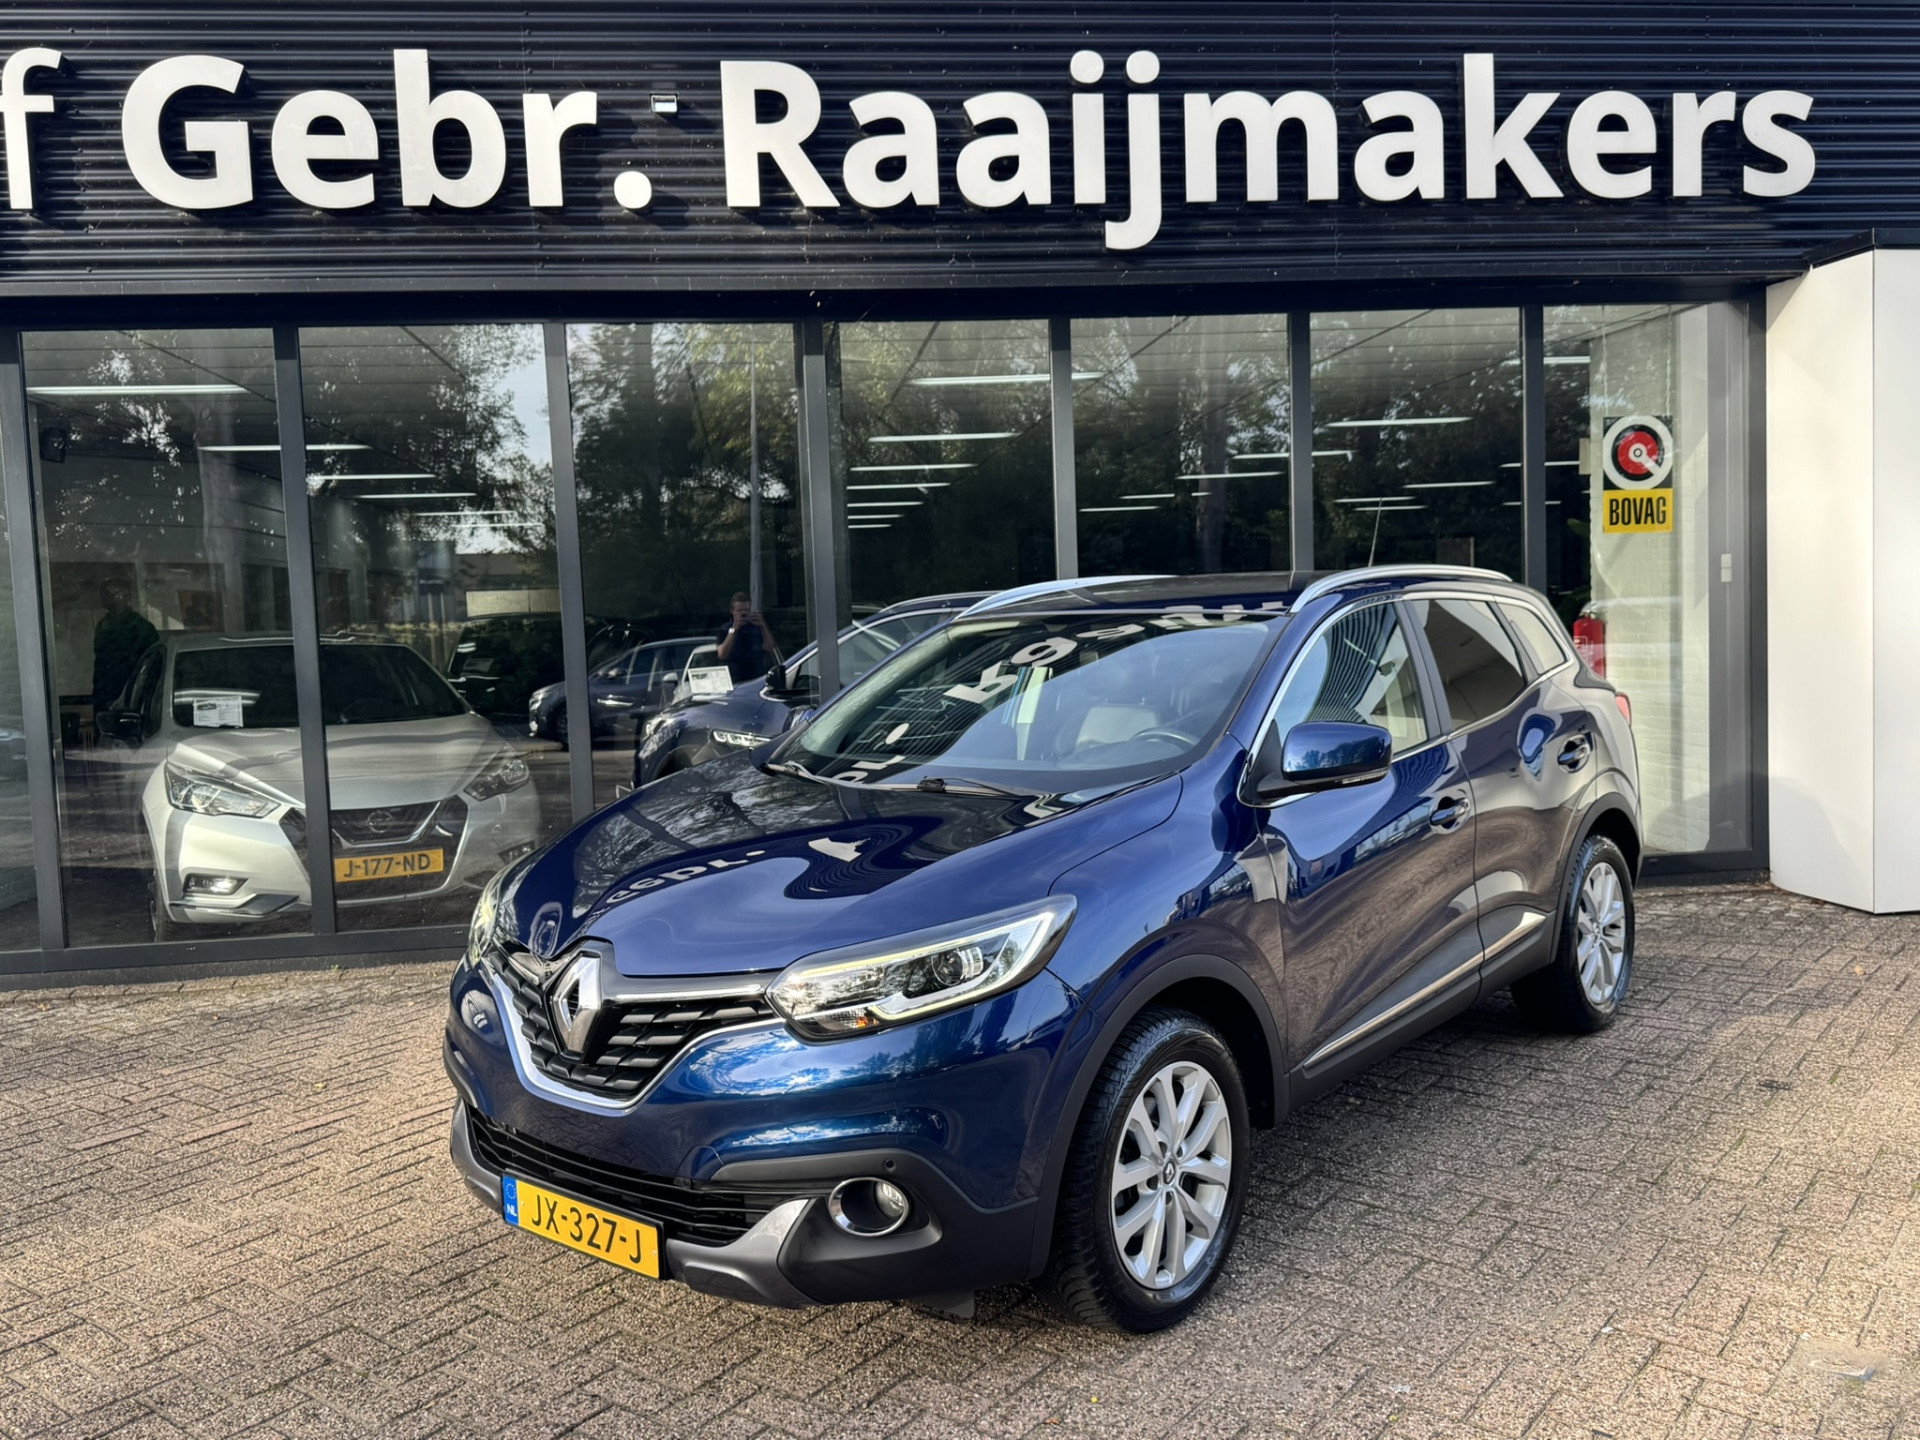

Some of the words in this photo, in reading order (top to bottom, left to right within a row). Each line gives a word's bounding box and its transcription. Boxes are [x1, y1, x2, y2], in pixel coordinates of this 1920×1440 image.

[121, 49, 653, 209] Gebr.
[720, 50, 1816, 250] Raaijmakers
[1609, 496, 1666, 526] BOVAG
[344, 853, 431, 878] J-177-ND
[507, 1203, 517, 1216] NL
[531, 1194, 642, 1264] JX-327-J
